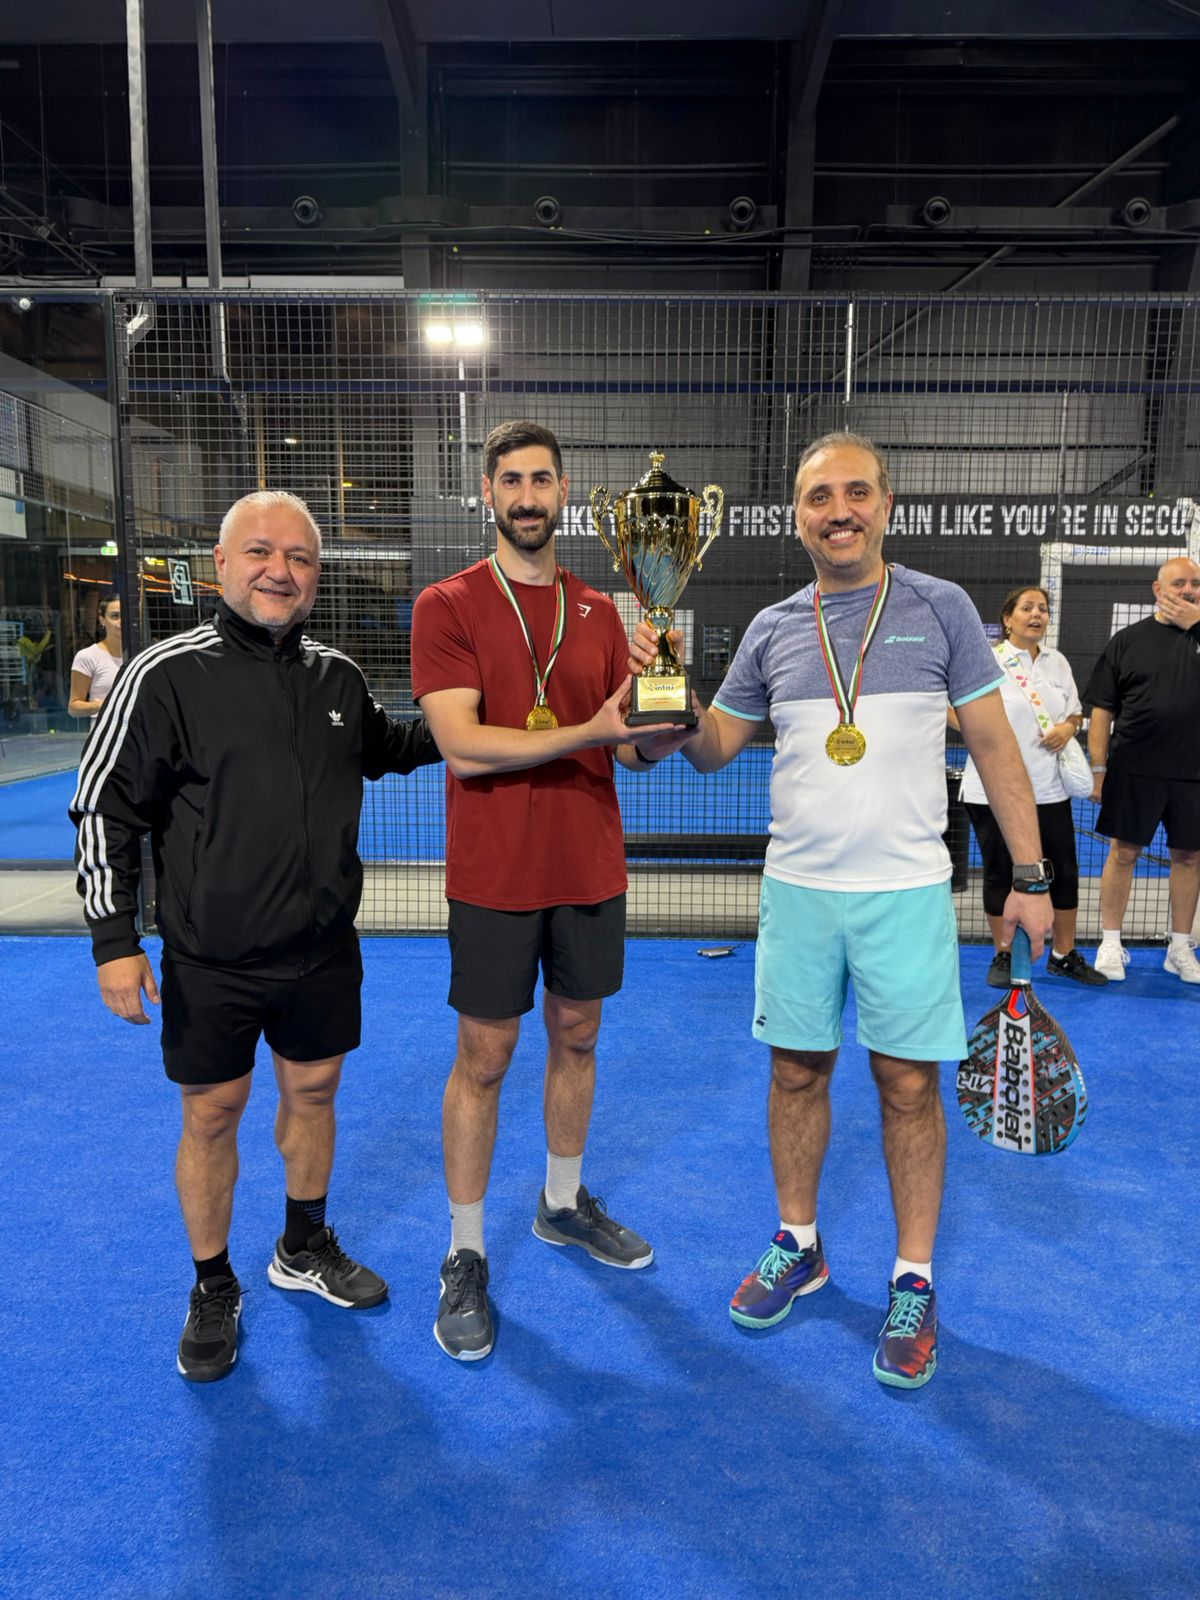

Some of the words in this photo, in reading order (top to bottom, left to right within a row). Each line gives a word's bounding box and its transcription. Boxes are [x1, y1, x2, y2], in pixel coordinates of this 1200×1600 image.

[554, 505, 600, 536] IKE
[885, 504, 932, 536] AIN
[940, 504, 993, 536] LIKE
[1001, 504, 1087, 536] YOU'RE
[1093, 504, 1119, 536] IN
[1124, 504, 1188, 536] SECO
